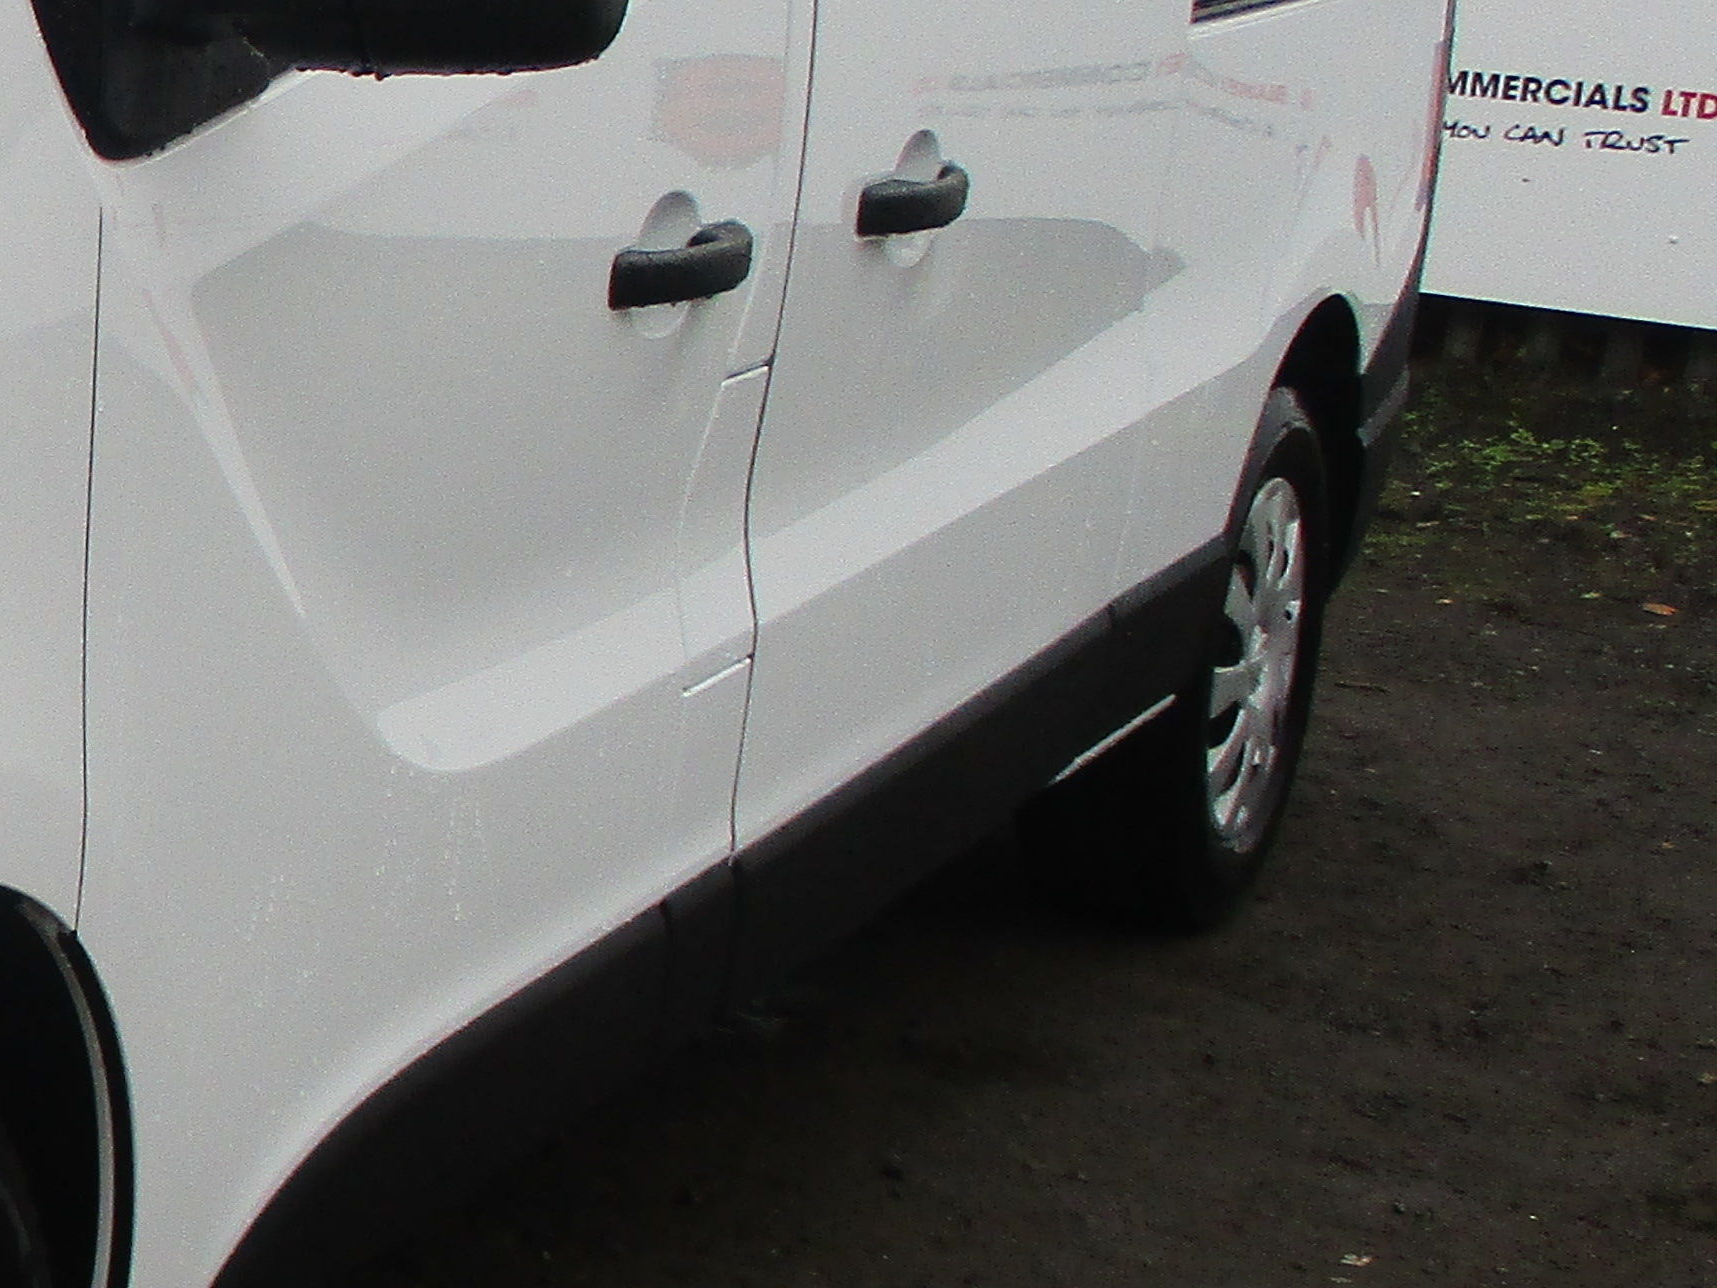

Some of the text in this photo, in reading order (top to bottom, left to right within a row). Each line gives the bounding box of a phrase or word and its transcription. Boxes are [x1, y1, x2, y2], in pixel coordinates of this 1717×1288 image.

[1660, 88, 1717, 120] LTD
[1505, 124, 1565, 147] CAN
[1584, 129, 1691, 155] TRUST
